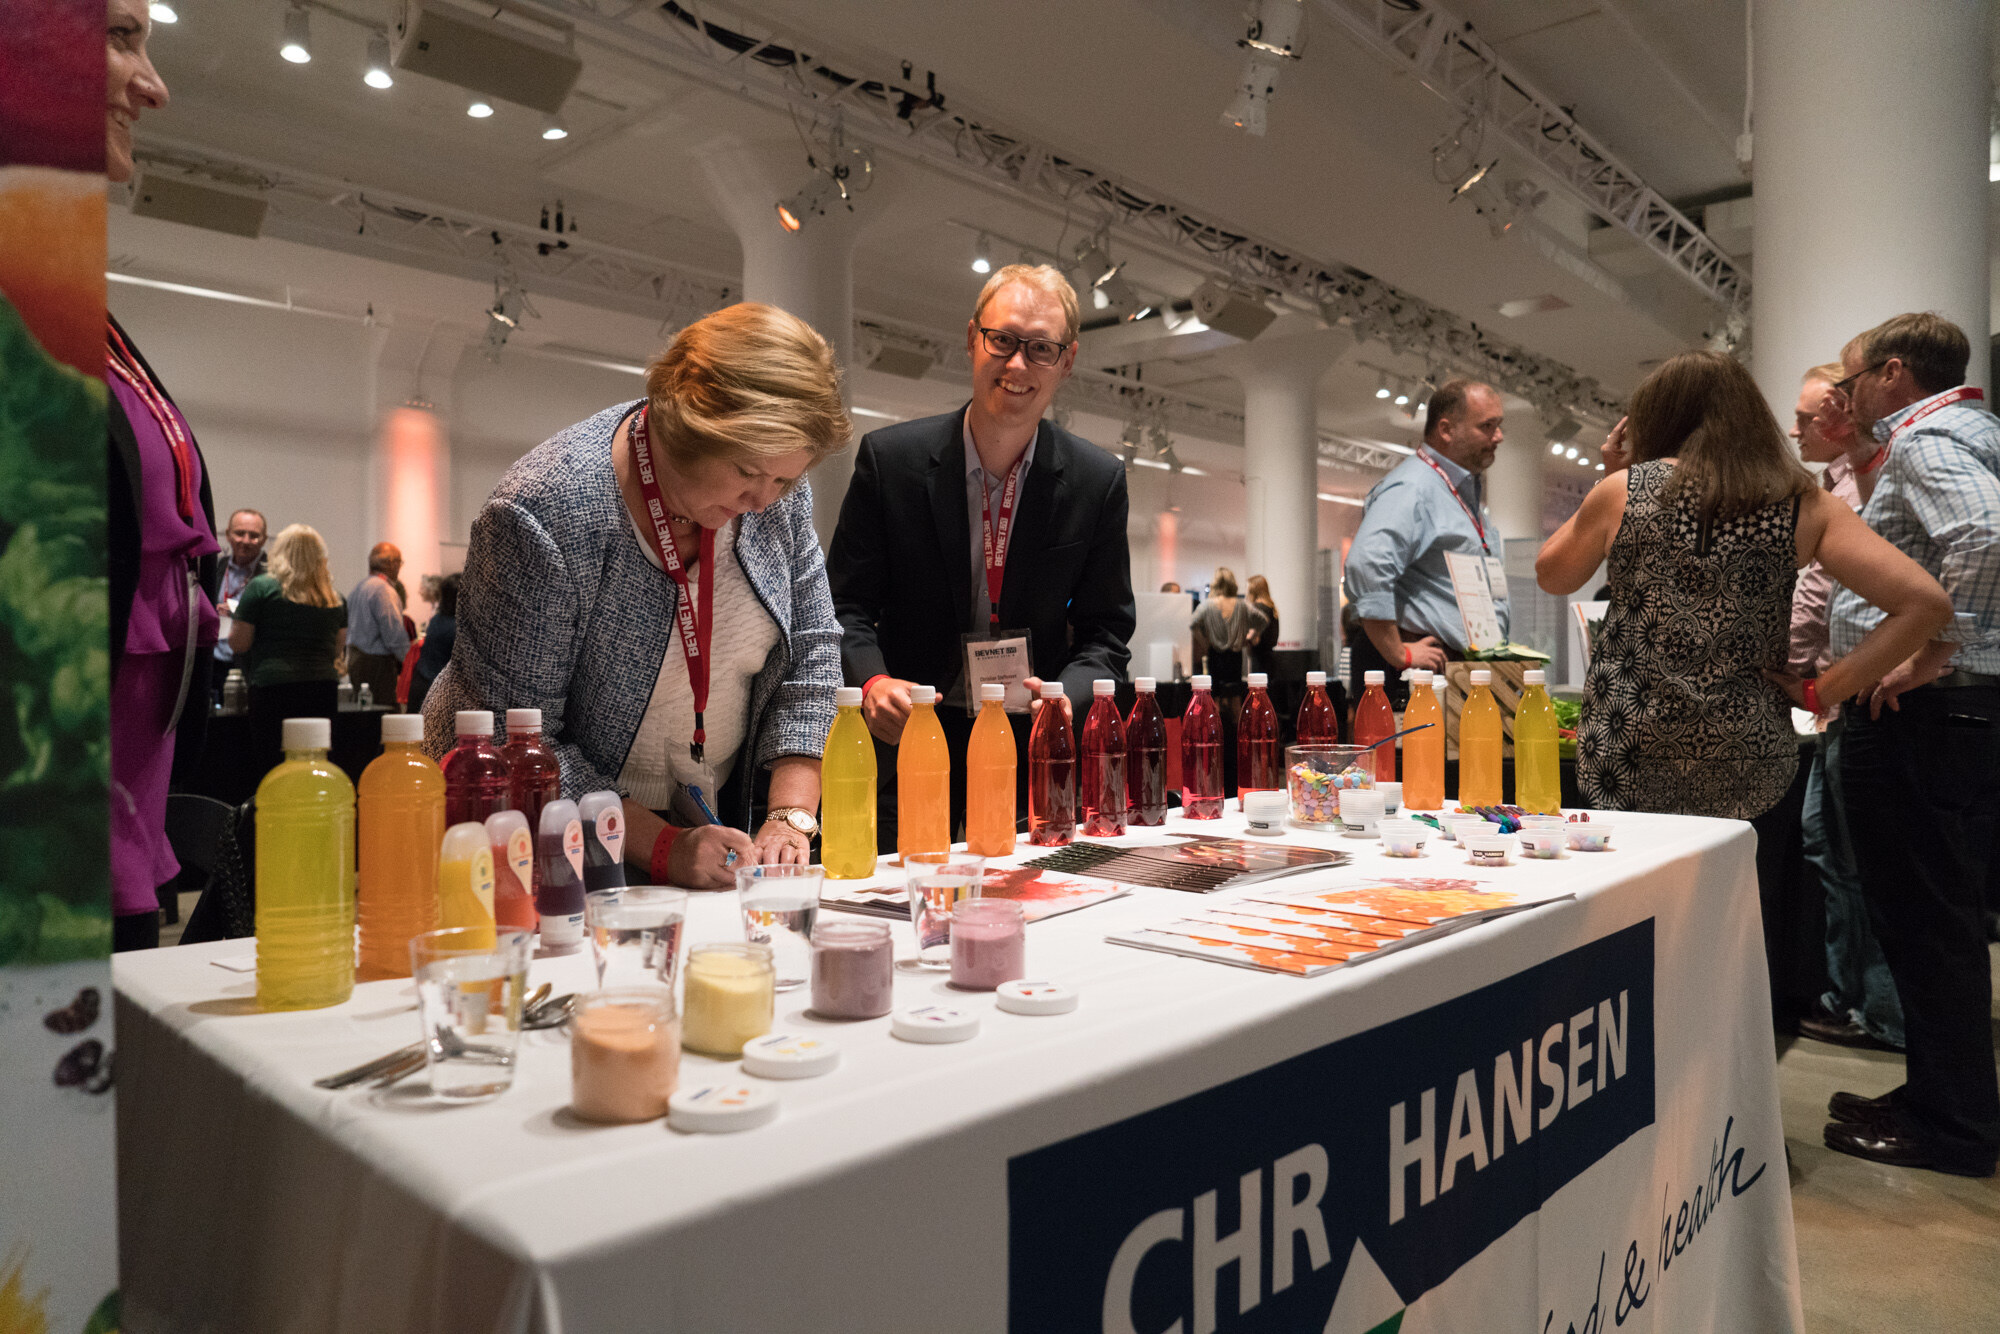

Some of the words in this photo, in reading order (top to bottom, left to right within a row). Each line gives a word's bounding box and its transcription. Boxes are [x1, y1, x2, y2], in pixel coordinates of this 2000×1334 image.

[634, 432, 655, 485] BEVNET
[648, 498, 664, 519] LIVE
[653, 518, 681, 571] BEVNET
[994, 531, 1006, 567] BEVNET
[676, 602, 700, 658] BEVNET
[974, 647, 1005, 657] BEVNET
[1102, 1143, 1332, 1334] CHR
[1389, 988, 1629, 1226] HANSEN
[1615, 1239, 1651, 1327] &
